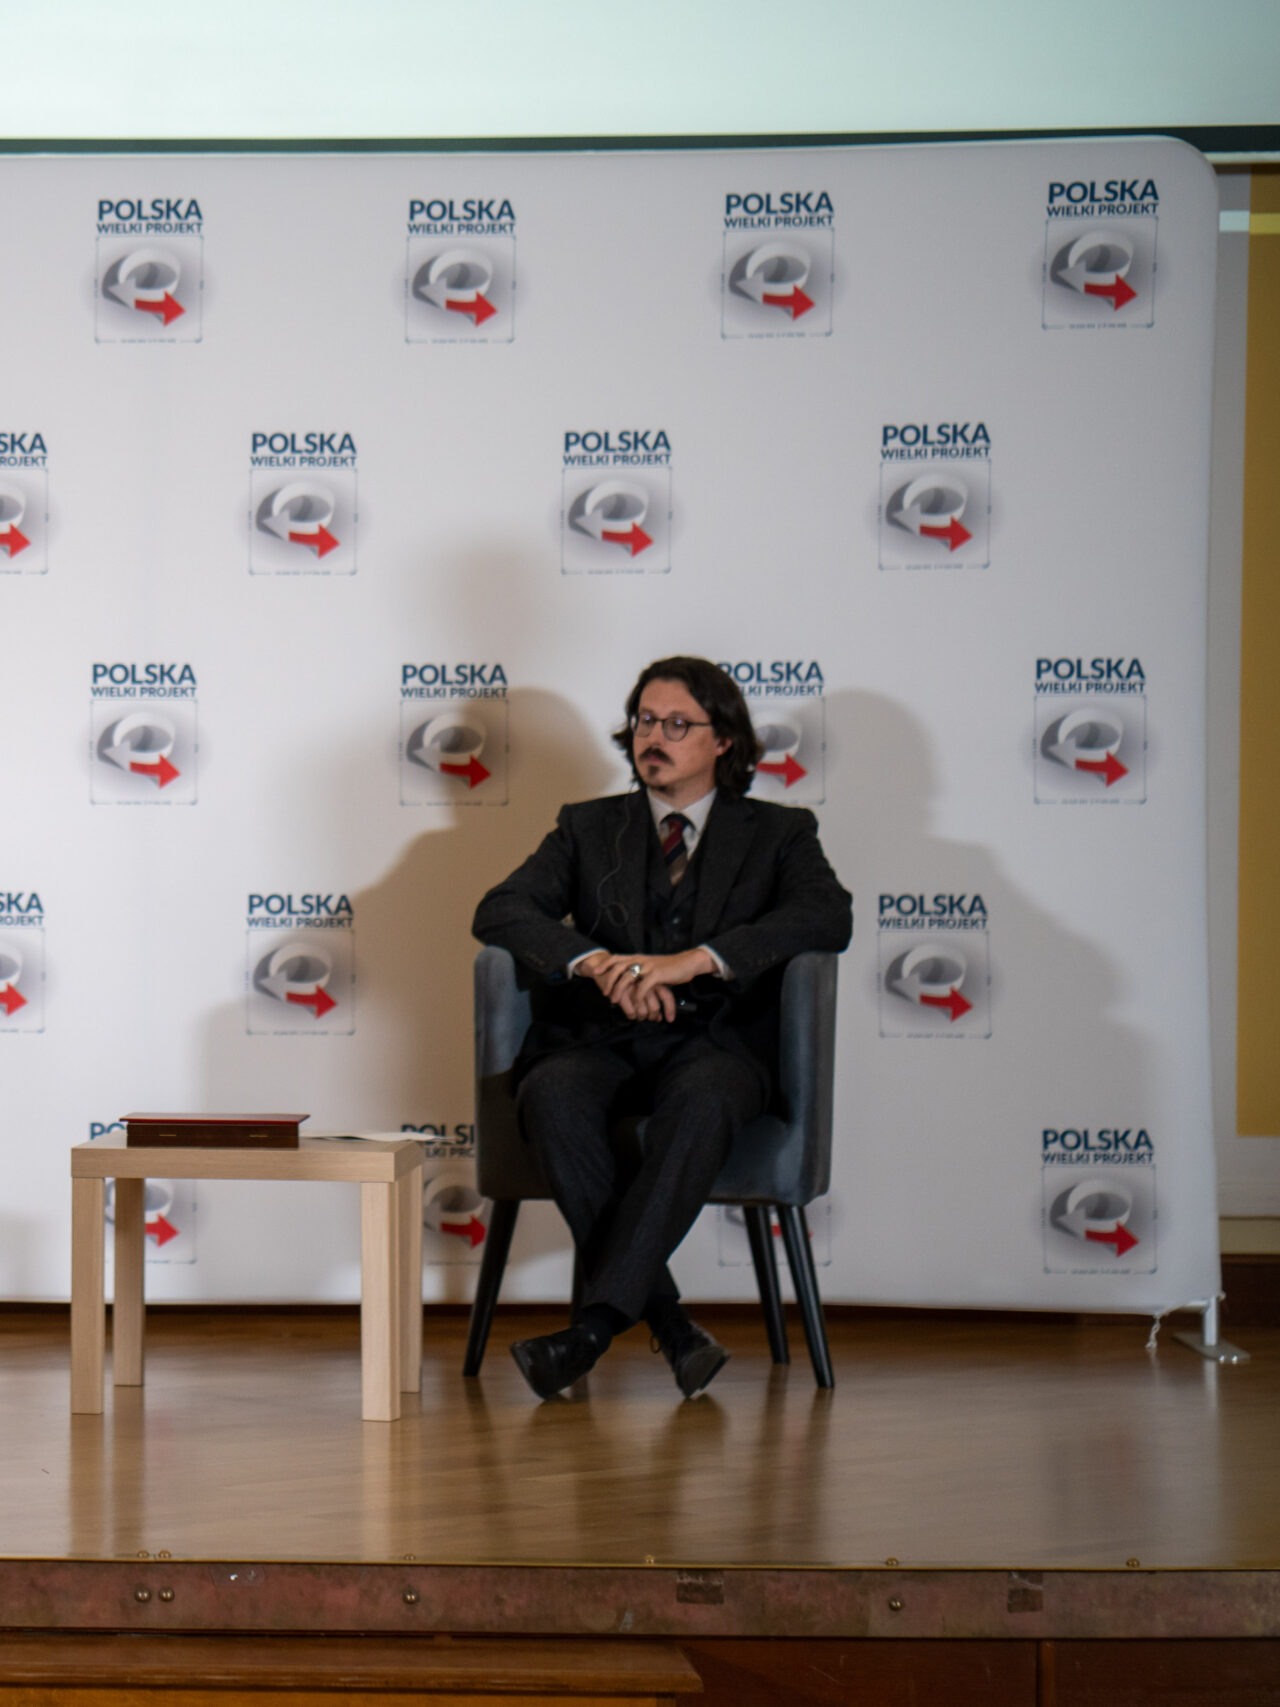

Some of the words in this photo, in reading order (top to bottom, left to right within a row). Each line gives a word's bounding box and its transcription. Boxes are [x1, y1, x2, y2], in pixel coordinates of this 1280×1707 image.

[1048, 180, 1159, 204] POLSKA
[725, 191, 833, 215] POLSKA
[1047, 205, 1094, 216] WIELKI
[1098, 203, 1159, 215] PROJEKT
[98, 199, 203, 221] POLSKA
[409, 199, 515, 221] POLSKA
[96, 224, 142, 234] WIELKI
[146, 222, 203, 233] PROJEKT
[407, 223, 454, 234] WIELKI
[458, 222, 515, 234] PROJEKT
[724, 216, 771, 228] WIELKI
[774, 215, 834, 227] PROJEKT
[882, 423, 991, 446] POLSKA
[252, 433, 357, 454] POLSKA
[564, 430, 671, 453] POLSKA
[562, 454, 609, 465] WIELKI
[612, 453, 671, 465] PROJEKT
[880, 448, 927, 459] WIELKI
[931, 446, 990, 459] PROJEKT
[250, 456, 296, 466] WIELKI
[299, 455, 357, 466] PROJEKT
[92, 663, 196, 684] POLSKA
[402, 664, 508, 685] POLSKA
[1035, 658, 1145, 680] POLSKA
[91, 687, 136, 697] WIELKI
[140, 686, 196, 697] PROJEKT
[400, 687, 446, 698] WIELKI
[450, 687, 508, 698] PROJEKT
[744, 685, 764, 696] LKI
[767, 685, 824, 696] PROJEKT
[1034, 682, 1082, 693] WIELKI
[1085, 682, 1145, 694] PROJEKT
[248, 894, 353, 915] POLSKA
[878, 894, 987, 916] POLSKA
[246, 917, 292, 927] WIELKI
[296, 917, 353, 928] PROJEKT
[877, 917, 925, 929] WIELKI
[929, 917, 987, 929] PROJEKT
[401, 1124, 475, 1145] OLS
[1042, 1129, 1153, 1150] POLSKA
[426, 1147, 446, 1158] LKI
[1041, 1153, 1090, 1164] WIELKI
[1093, 1153, 1153, 1164] PROJEKT
